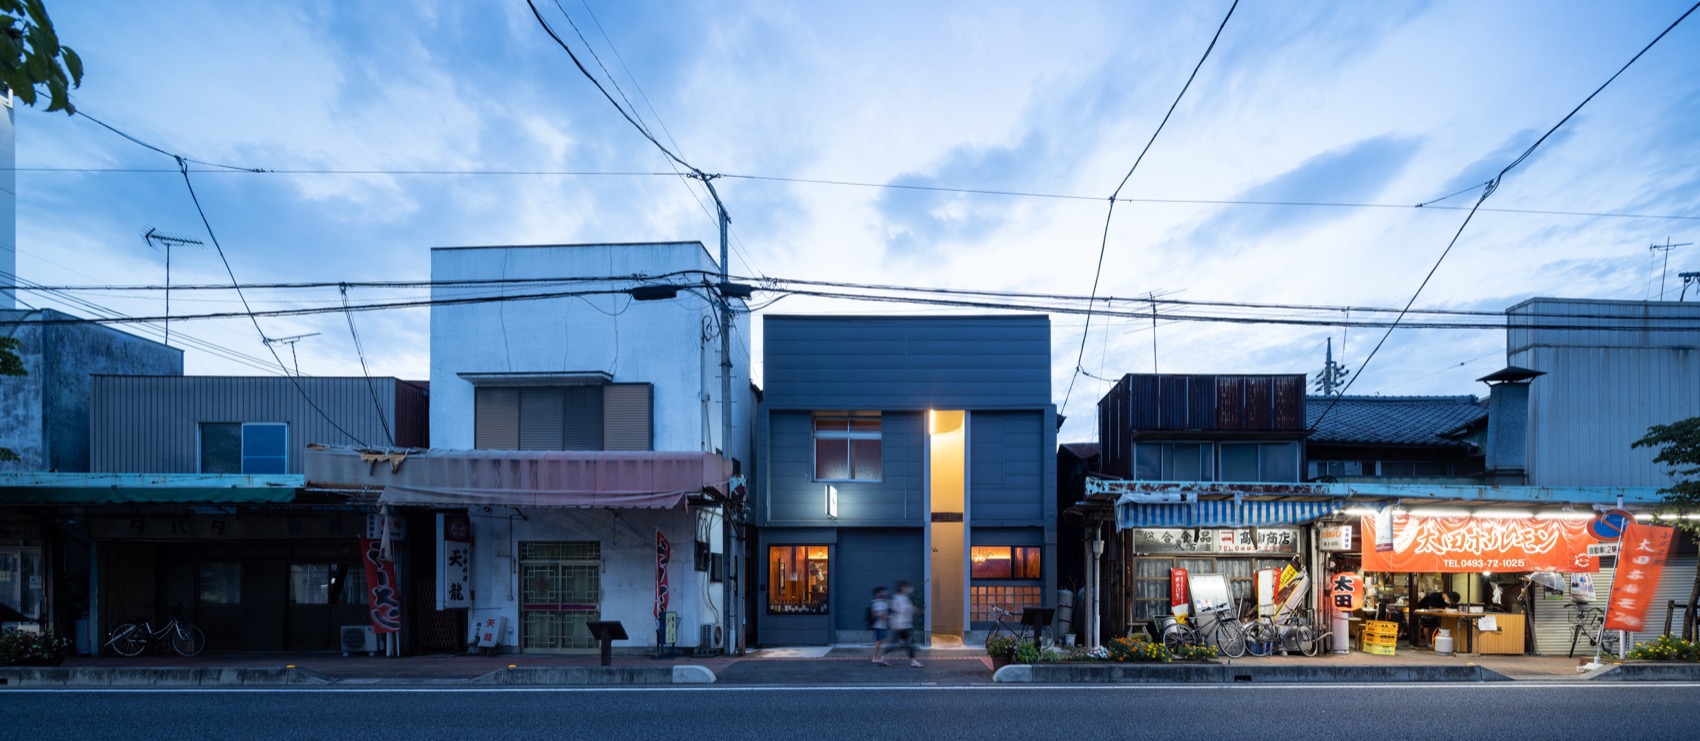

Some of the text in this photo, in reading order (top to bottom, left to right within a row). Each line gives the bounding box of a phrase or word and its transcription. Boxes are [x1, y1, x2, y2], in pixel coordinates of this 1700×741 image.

[1143, 530, 1212, 544] 総合食品
[1414, 521, 1559, 555] 太田ホルモン
[449, 549, 464, 601] 天龍
[1334, 575, 1354, 608] 太田
